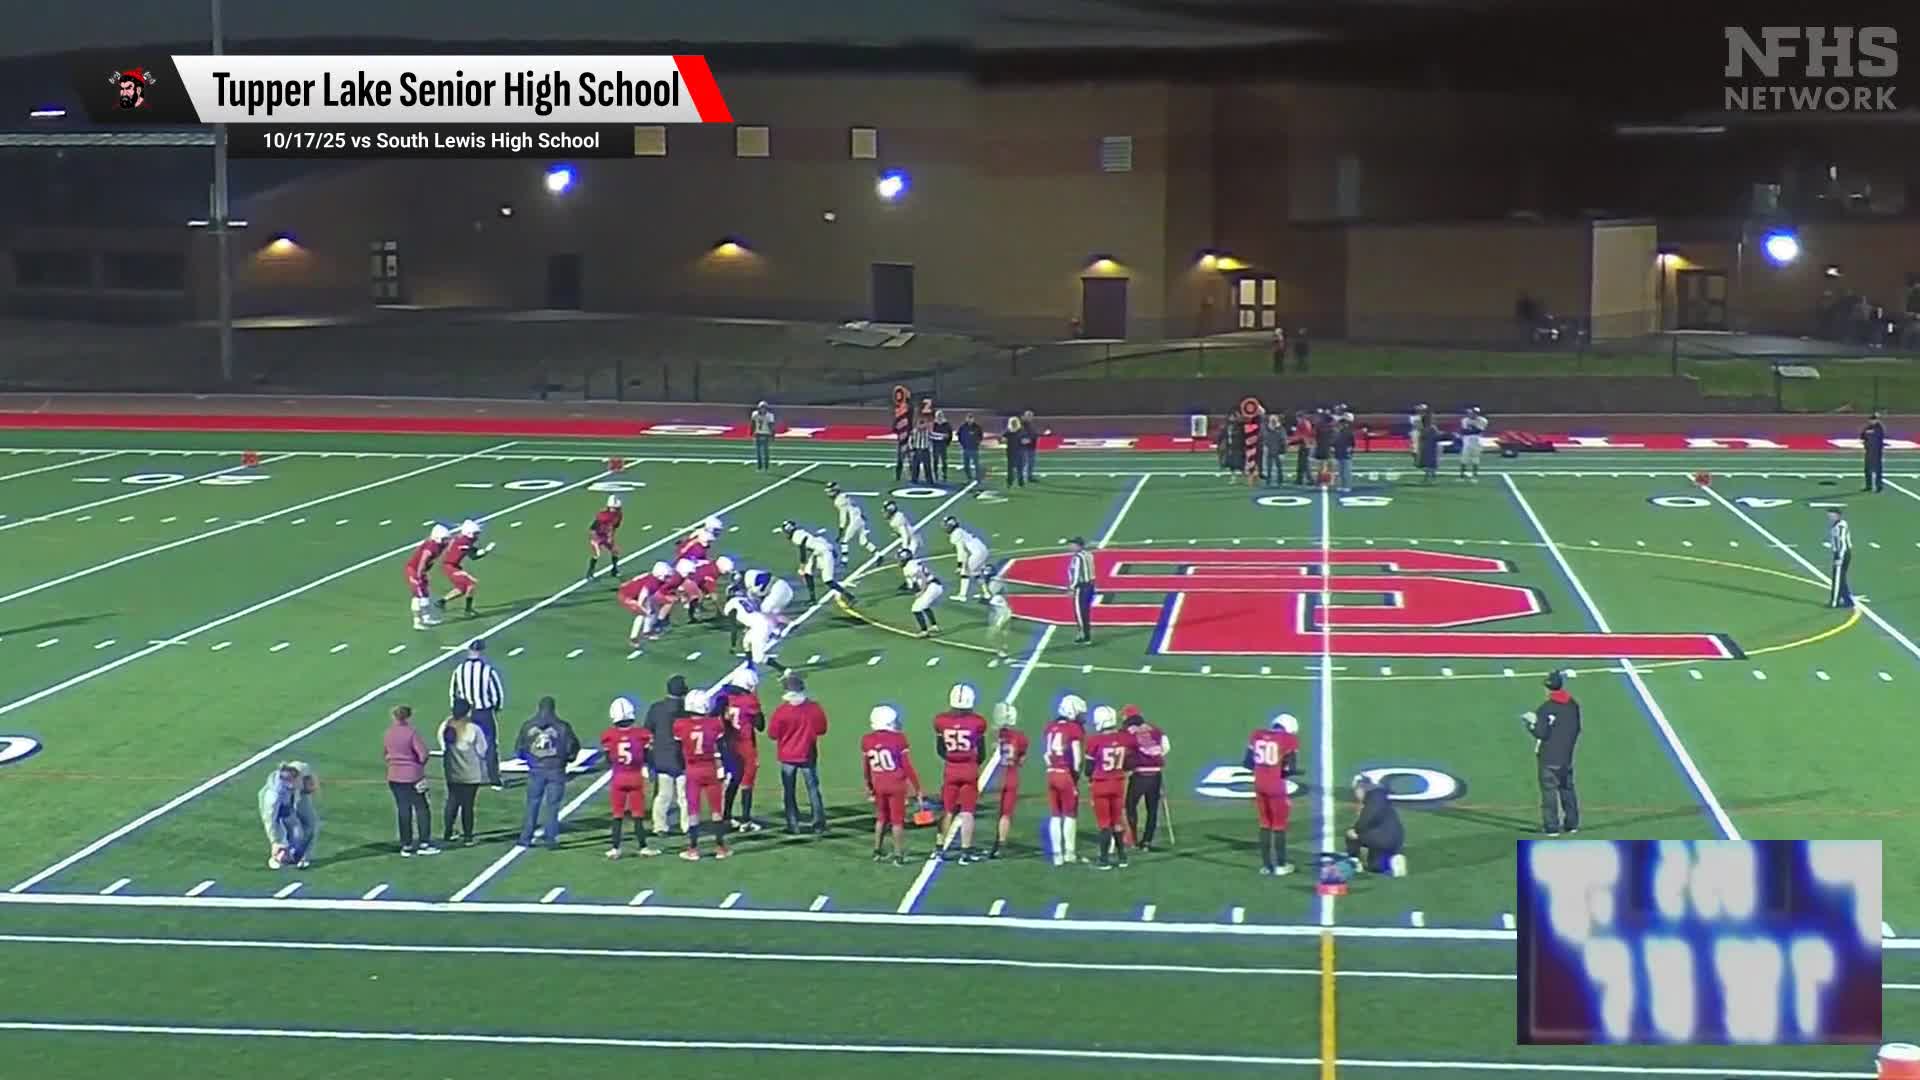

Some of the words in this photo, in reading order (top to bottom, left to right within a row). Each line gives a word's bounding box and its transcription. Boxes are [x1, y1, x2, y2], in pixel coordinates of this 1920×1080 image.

[1256, 495, 1393, 506] 50
[1652, 496, 1793, 507] 40
[690, 731, 704, 755] 7
[943, 729, 971, 752] 55
[617, 742, 632, 764] 5
[868, 748, 896, 772] 20
[1102, 746, 1126, 771] 57
[1253, 740, 1279, 766] 50
